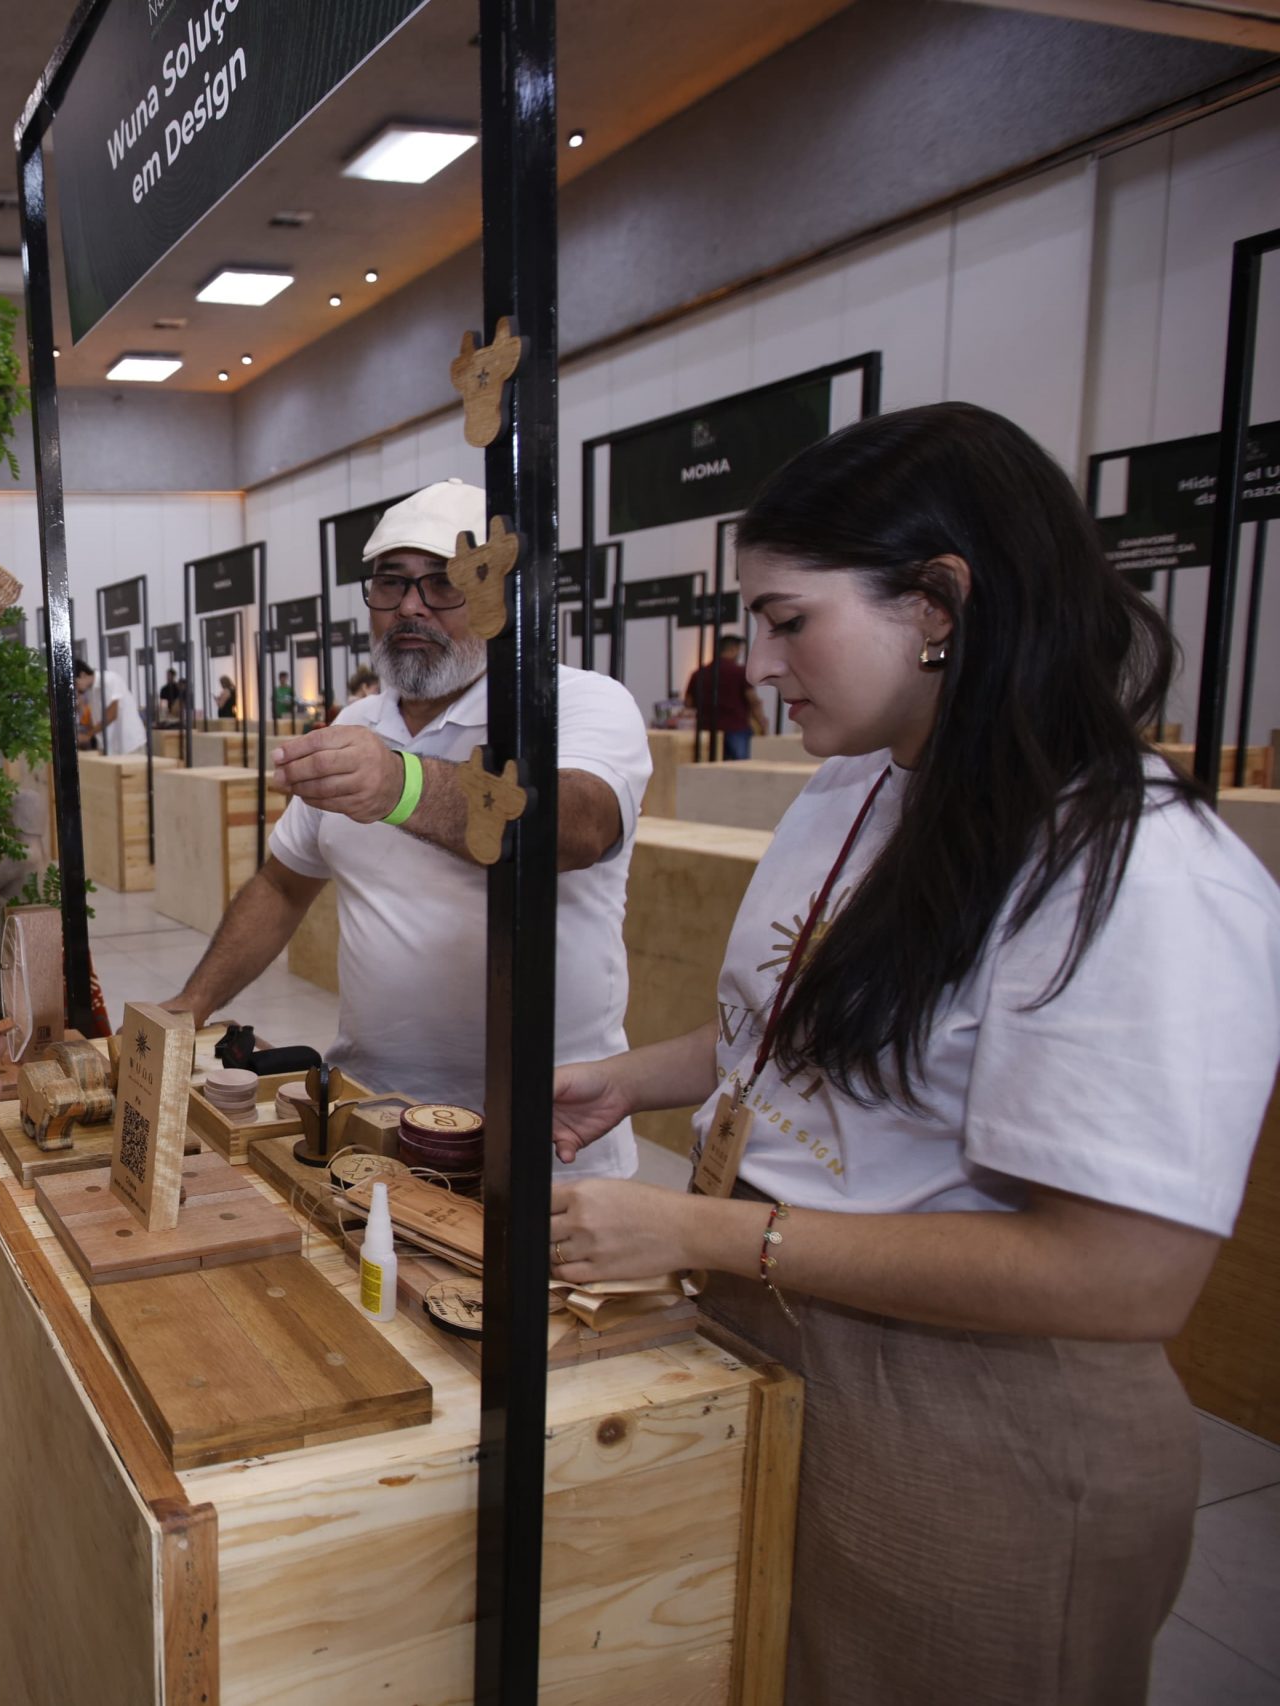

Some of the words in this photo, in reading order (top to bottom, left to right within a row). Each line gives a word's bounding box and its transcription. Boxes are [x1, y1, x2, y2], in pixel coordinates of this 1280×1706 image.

[107, 85, 159, 171] Wuna
[132, 151, 161, 203] em
[165, 47, 247, 166] Design
[681, 458, 730, 482] MOMA
[768, 1112, 845, 1176] DESIGN
